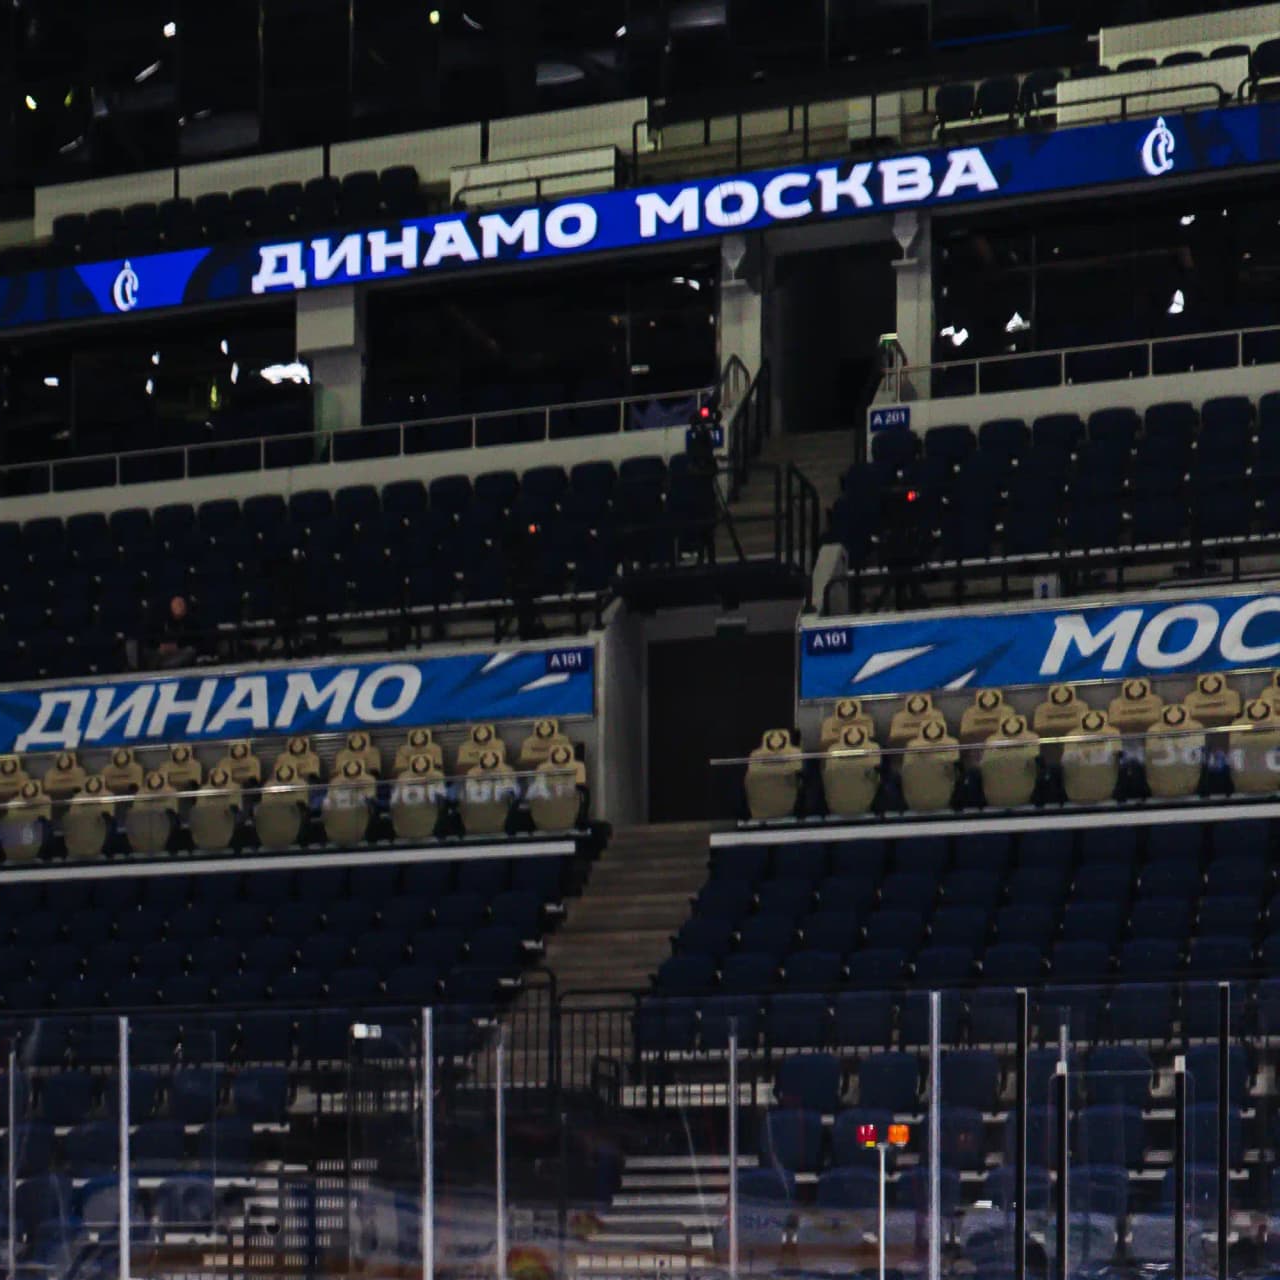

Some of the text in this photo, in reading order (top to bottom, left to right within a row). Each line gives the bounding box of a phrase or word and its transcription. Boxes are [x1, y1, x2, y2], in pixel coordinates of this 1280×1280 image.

[251, 147, 1000, 295] ДИНАМО МОСКВА
[14, 664, 423, 754] ДИНАМО
